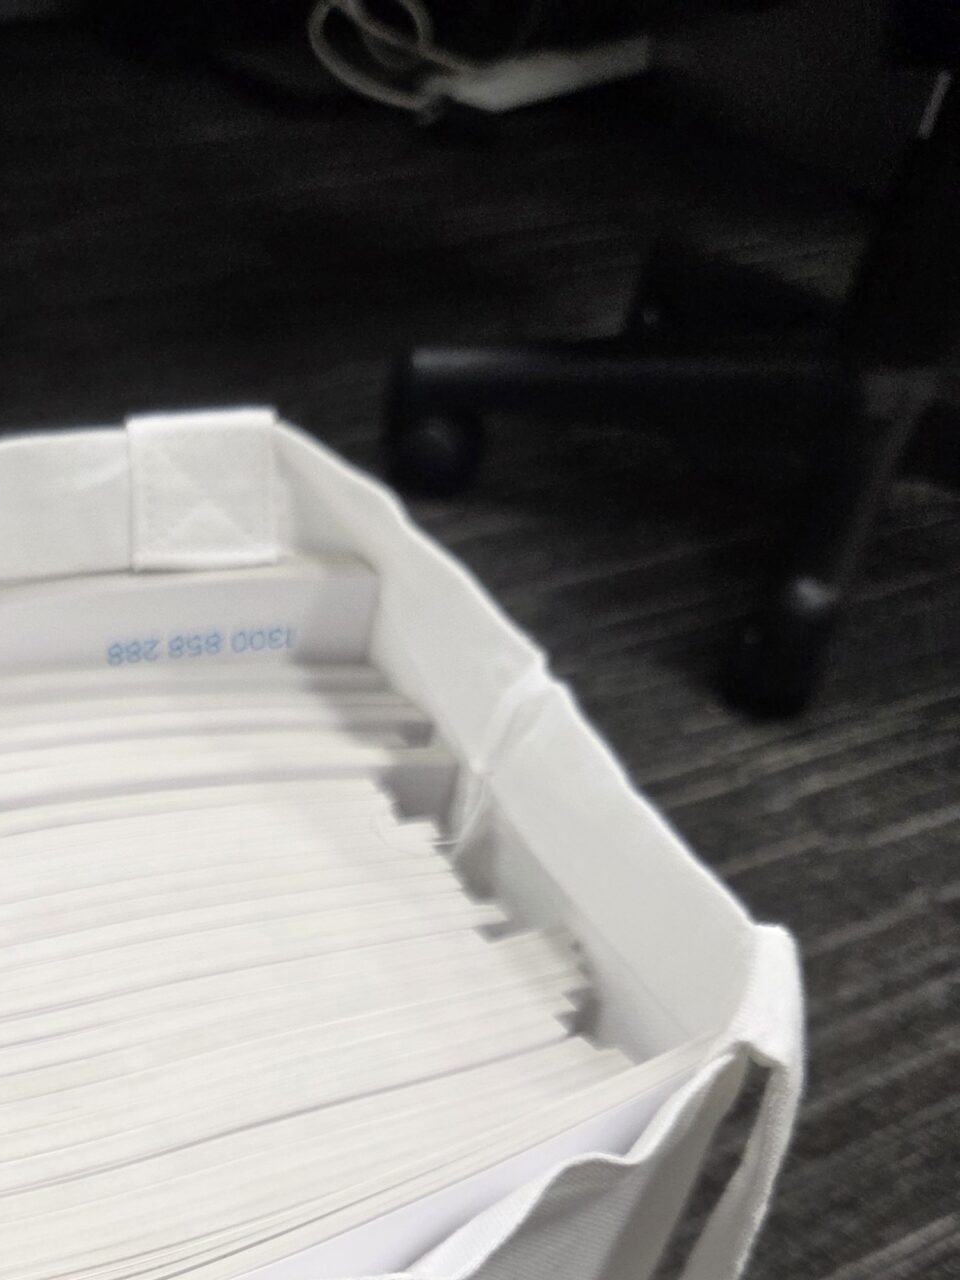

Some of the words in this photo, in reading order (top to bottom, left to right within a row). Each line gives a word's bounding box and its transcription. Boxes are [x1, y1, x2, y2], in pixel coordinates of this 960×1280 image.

[107, 639, 158, 666] 288
[168, 632, 223, 658] 858
[231, 627, 296, 653] 1300
